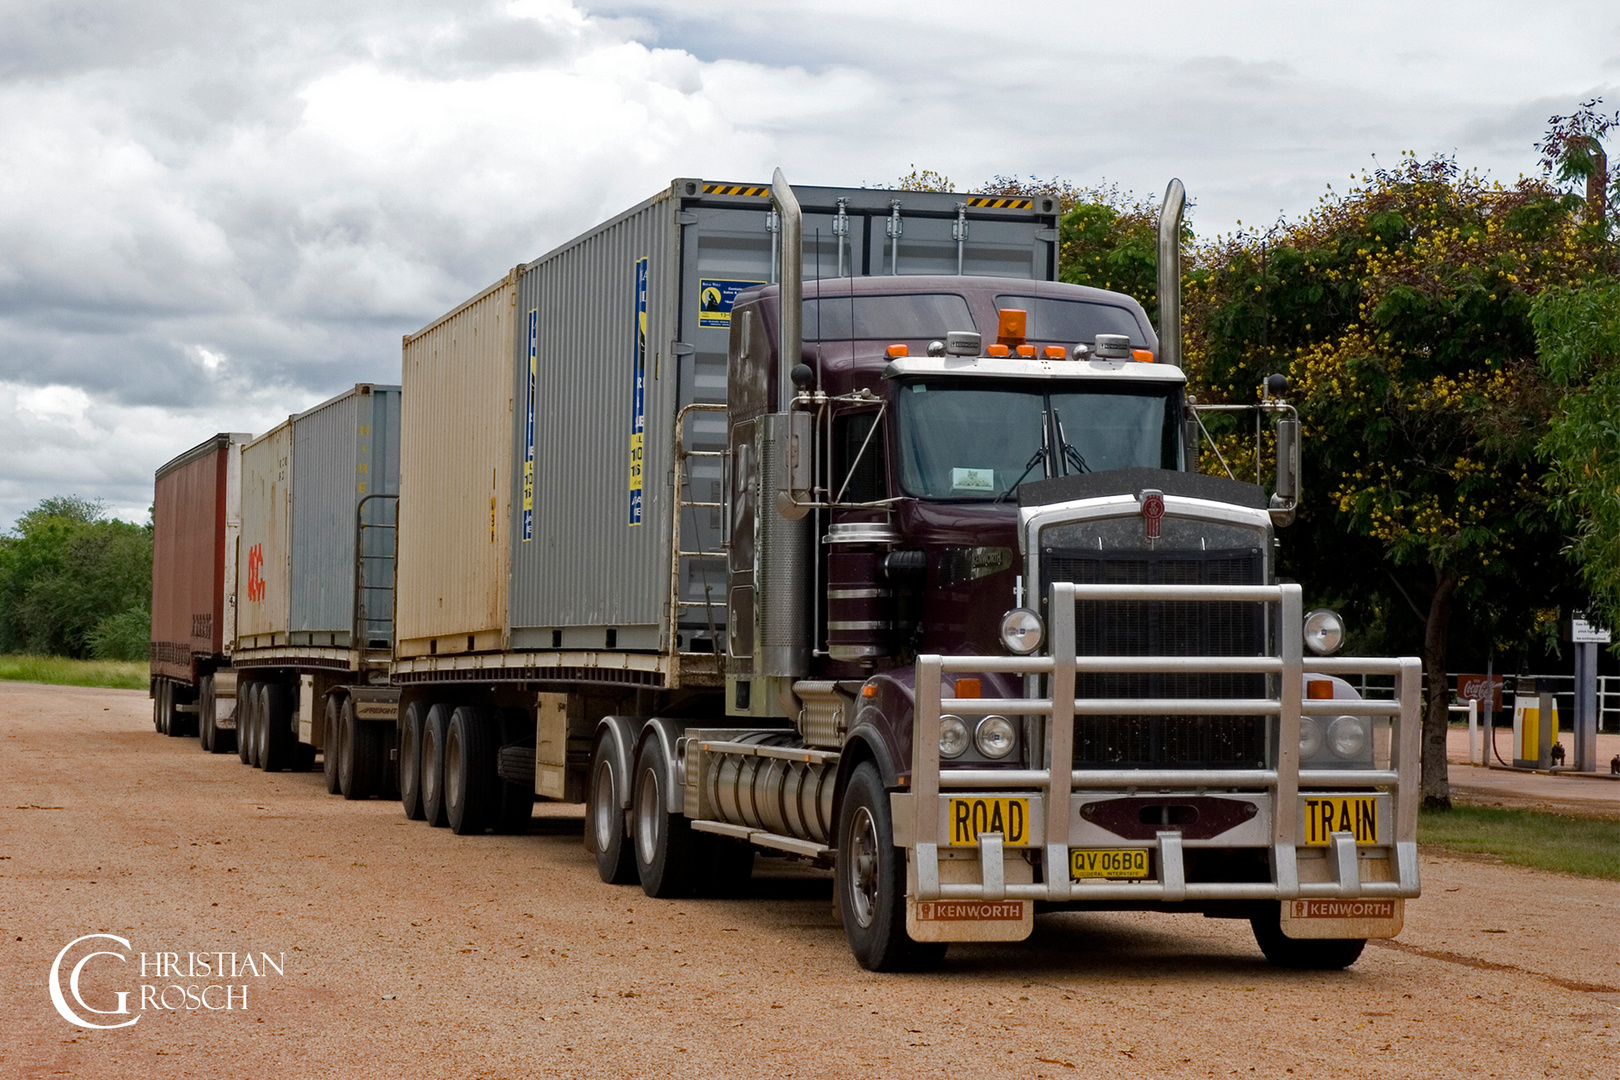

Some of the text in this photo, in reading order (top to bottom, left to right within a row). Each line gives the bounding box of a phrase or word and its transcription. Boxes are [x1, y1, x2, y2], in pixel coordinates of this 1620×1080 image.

[955, 800, 1023, 842] ROAD
[1307, 800, 1376, 842] TRAIN
[937, 903, 1020, 918] KENWORTH
[1310, 903, 1391, 917] KENWORTH
